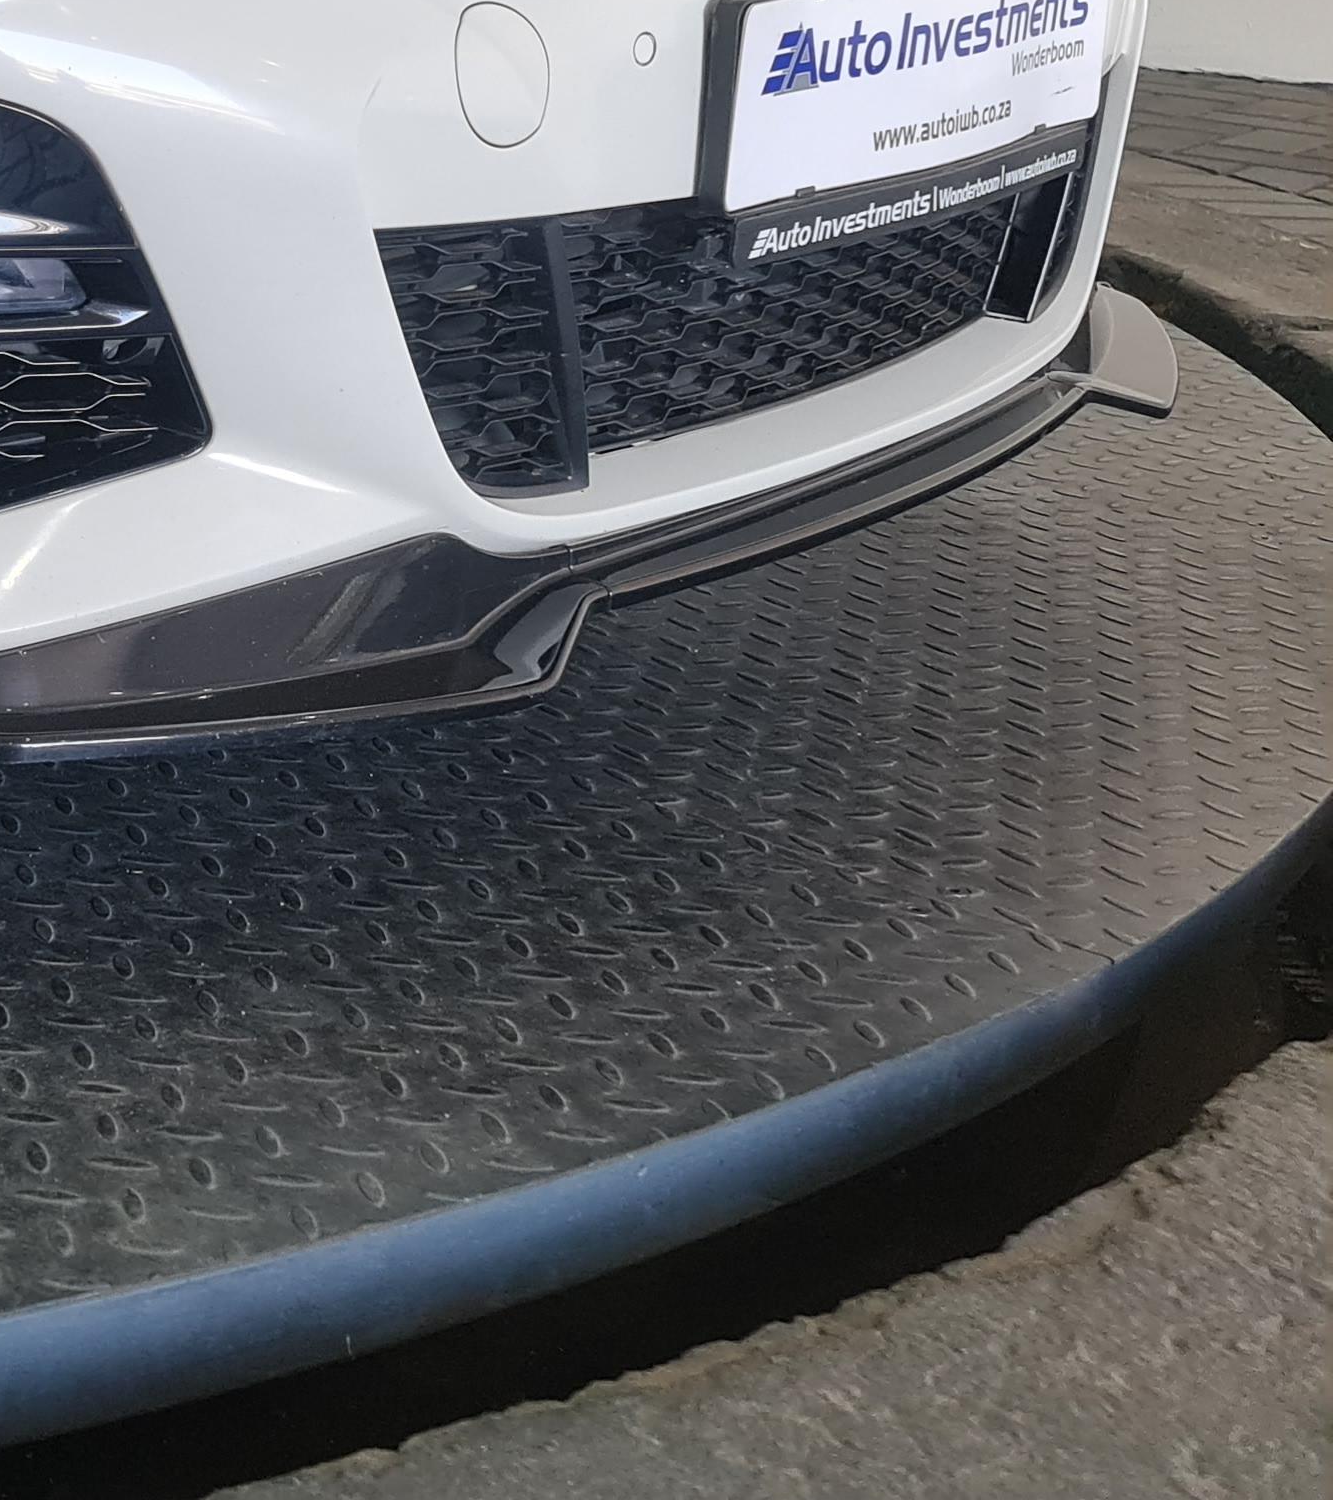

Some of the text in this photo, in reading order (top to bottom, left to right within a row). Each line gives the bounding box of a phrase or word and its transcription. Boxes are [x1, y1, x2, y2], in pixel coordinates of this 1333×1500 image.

[785, 19, 893, 91] Auto
[1010, 39, 1085, 77] Wonderboom
[872, 99, 1012, 152] www.autoiwb.co.za
[761, 206, 811, 257] Auto
[810, 190, 931, 244] Investments
[938, 176, 1001, 210] Wonderboom
